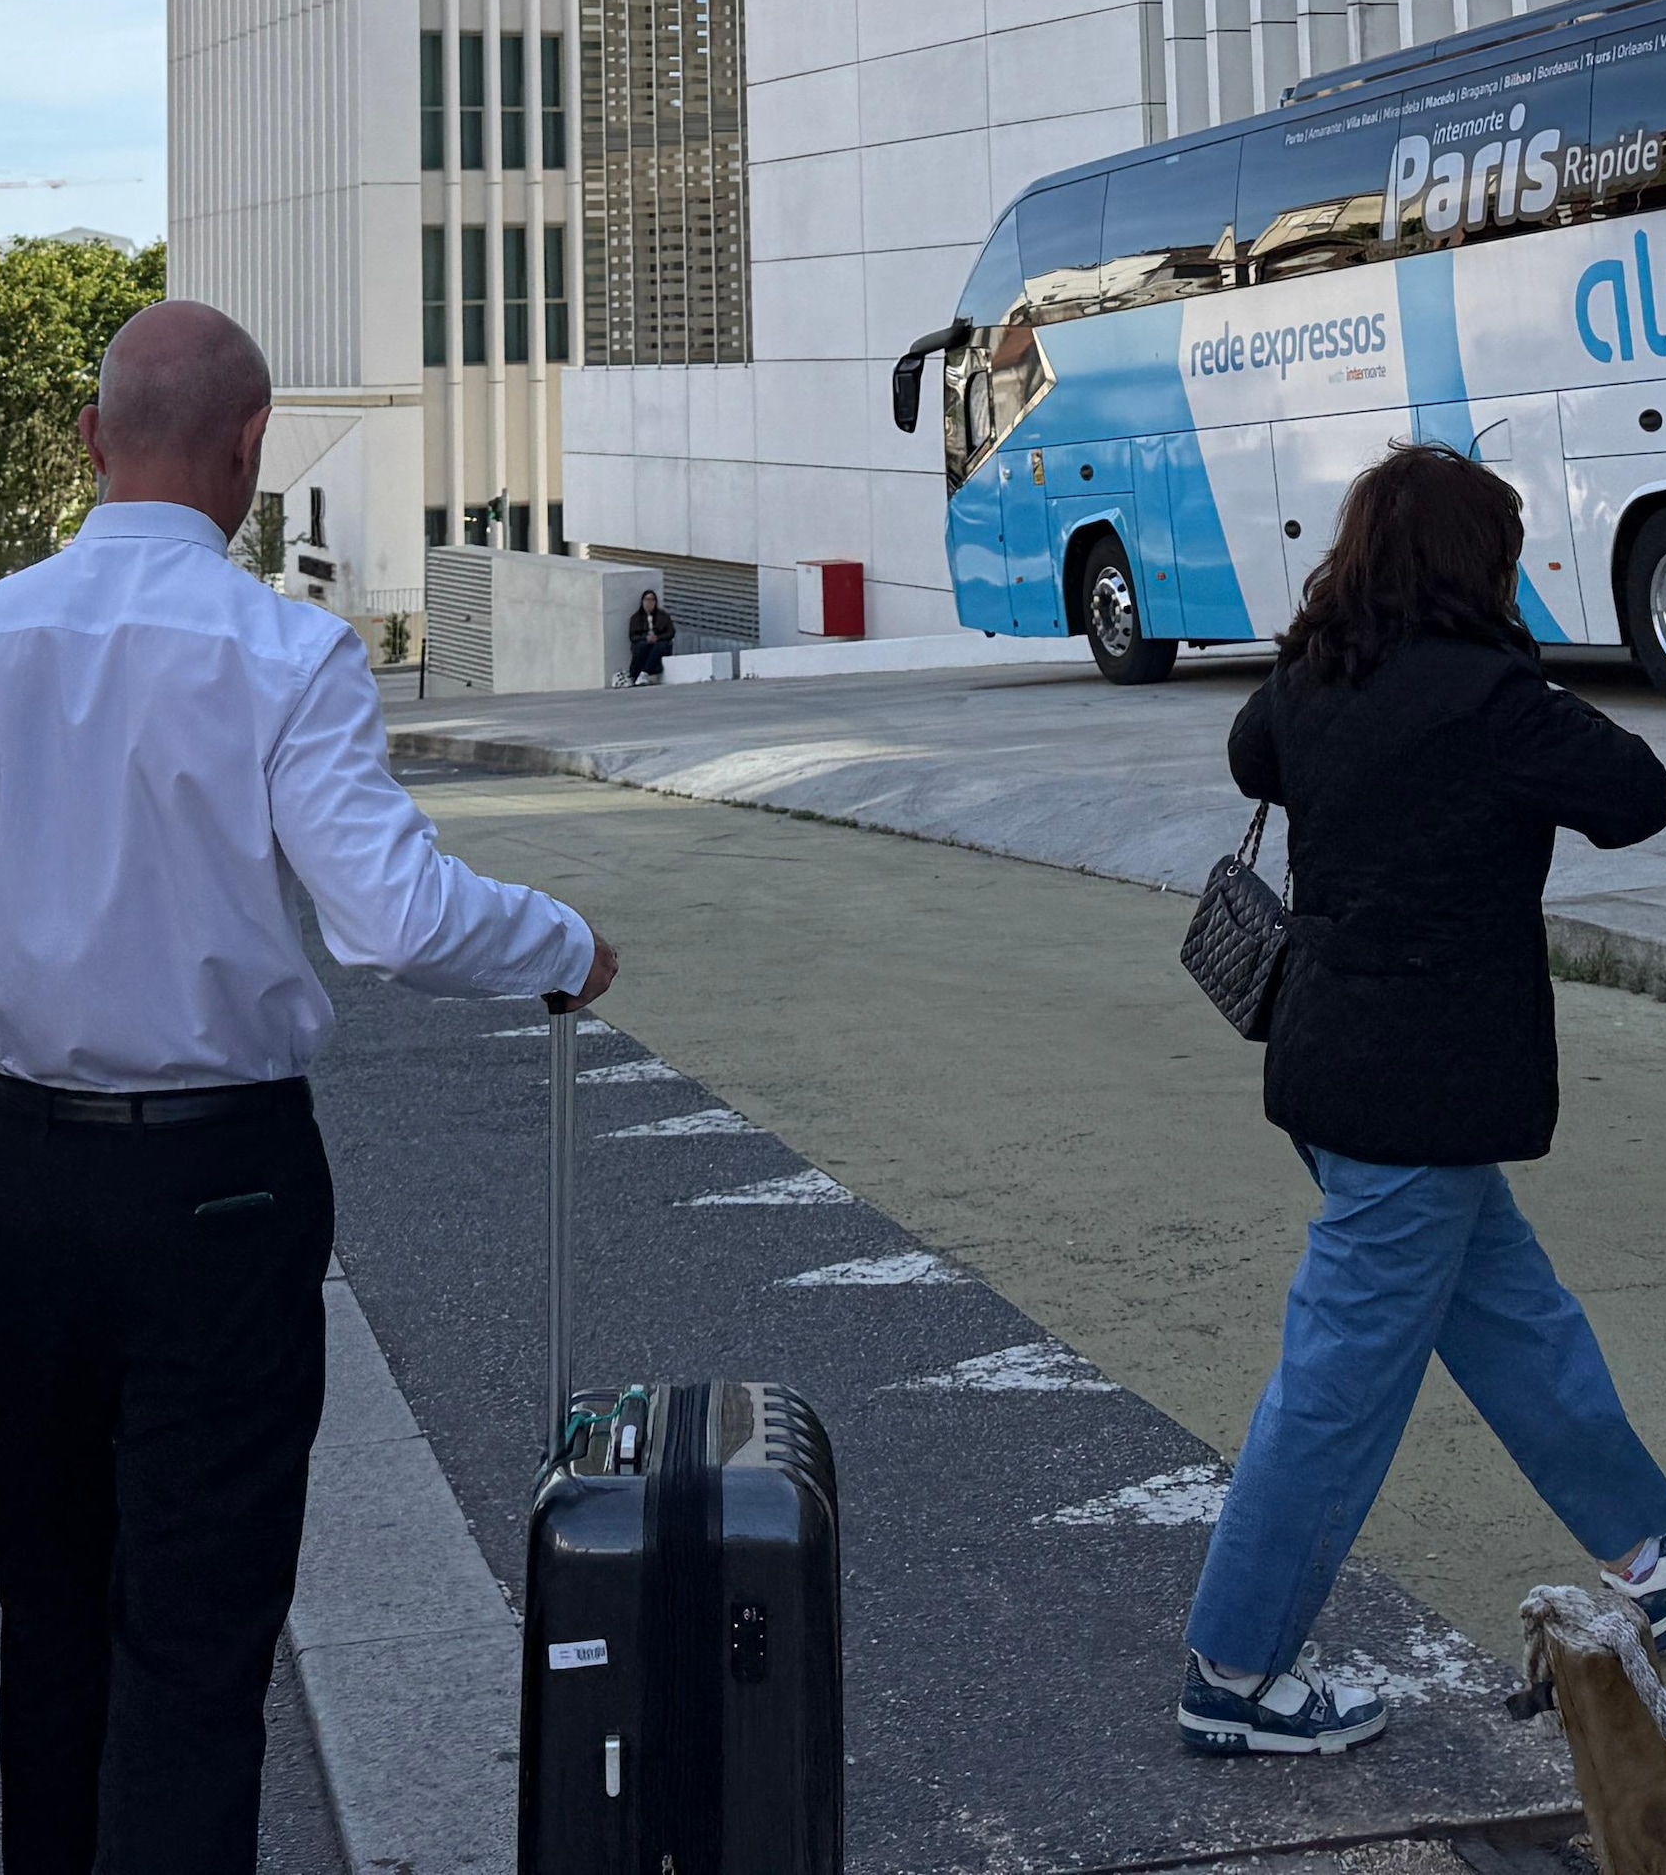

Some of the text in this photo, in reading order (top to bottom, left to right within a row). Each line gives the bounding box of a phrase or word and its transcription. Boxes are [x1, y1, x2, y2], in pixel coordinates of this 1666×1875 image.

[1285, 132, 1303, 146] Porto
[1346, 117, 1361, 130] Vila
[1361, 110, 1379, 127] Real
[1425, 91, 1456, 110] Macedo
[1460, 80, 1499, 101] Bragança
[1504, 71, 1532, 89] Bilbao
[1538, 57, 1580, 81] Bordeaux
[1585, 50, 1612, 68] Tours
[1617, 38, 1654, 59] Orleans
[1433, 109, 1504, 145] internorte
[1383, 102, 1660, 243] Paris Rapide
[1191, 312, 1387, 381] rede expressos
